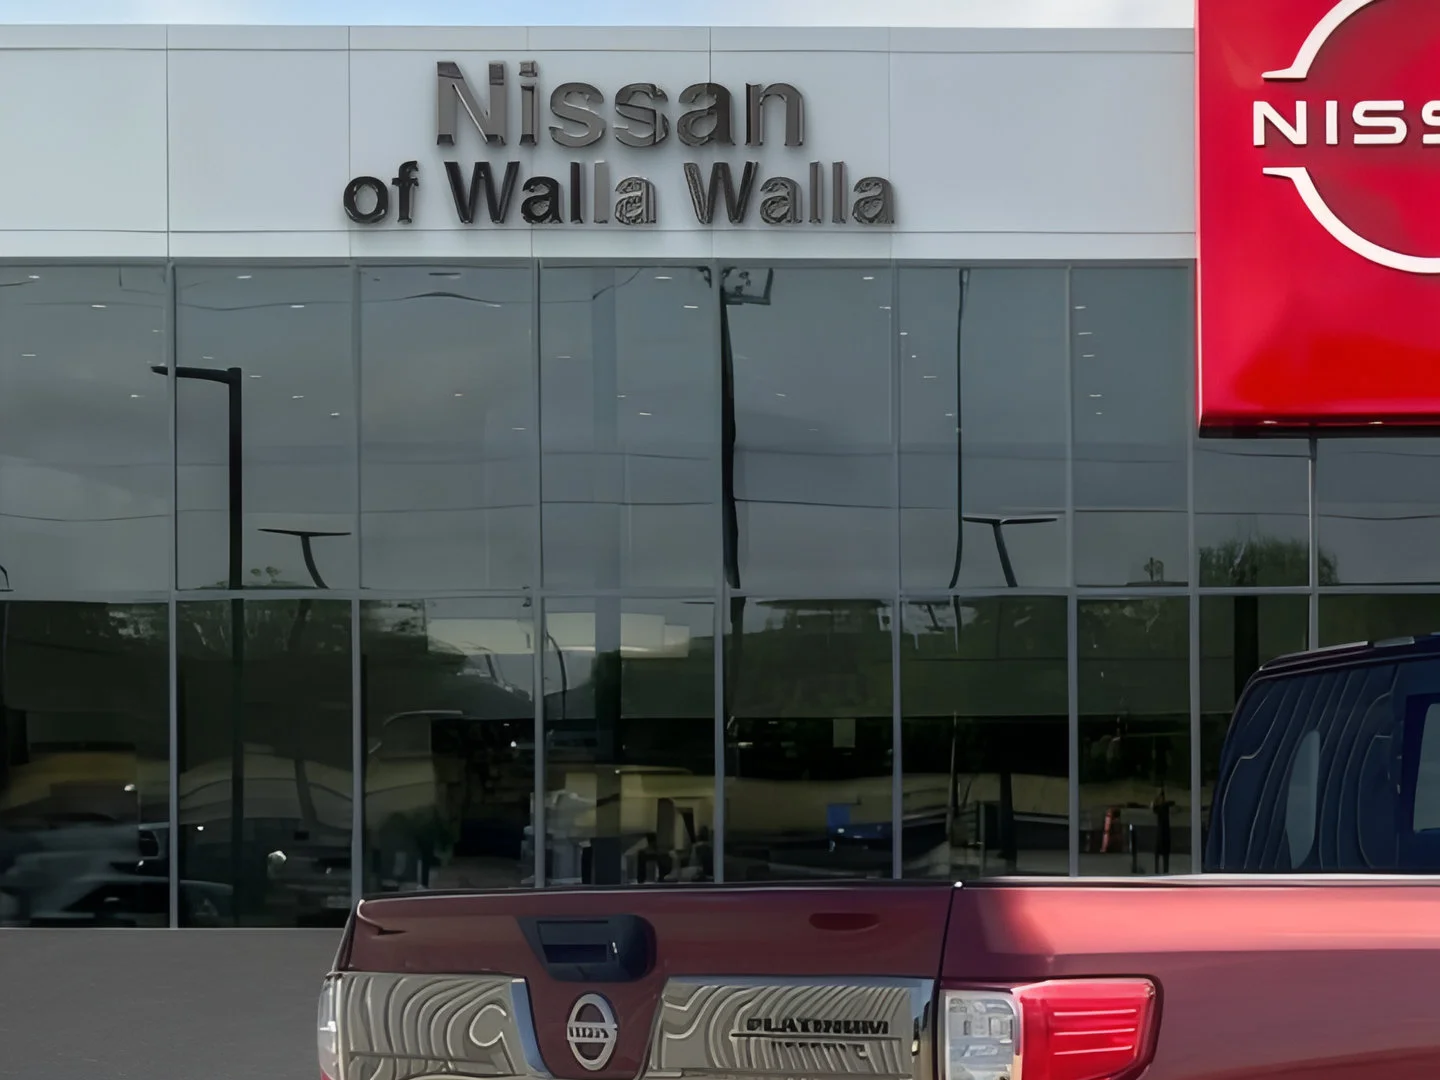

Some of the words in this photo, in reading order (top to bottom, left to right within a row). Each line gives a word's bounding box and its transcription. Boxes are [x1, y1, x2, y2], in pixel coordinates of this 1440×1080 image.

[436, 60, 805, 148] Nissan
[343, 160, 419, 224] of
[444, 160, 657, 225] Walla
[683, 160, 896, 225] Walla
[746, 1018, 889, 1035] PLATINUM
